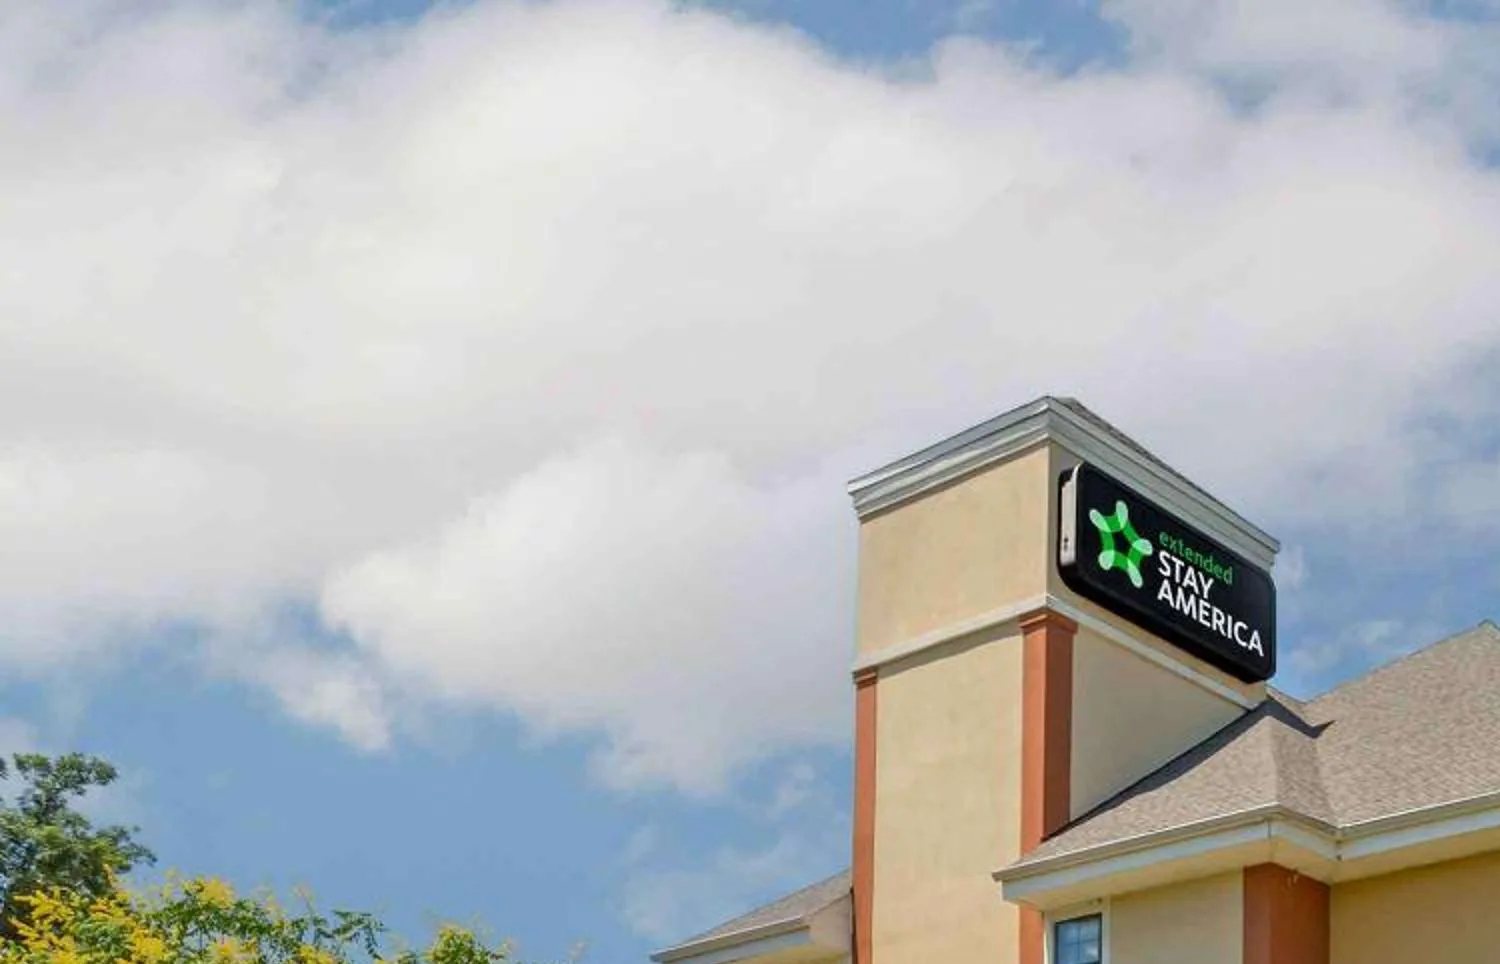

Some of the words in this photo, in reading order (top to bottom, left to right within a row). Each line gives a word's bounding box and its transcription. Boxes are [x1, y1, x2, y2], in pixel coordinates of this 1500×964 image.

[1158, 551, 1214, 599] STAY
[1159, 531, 1233, 584] extended
[1158, 579, 1264, 657] AMERICA
